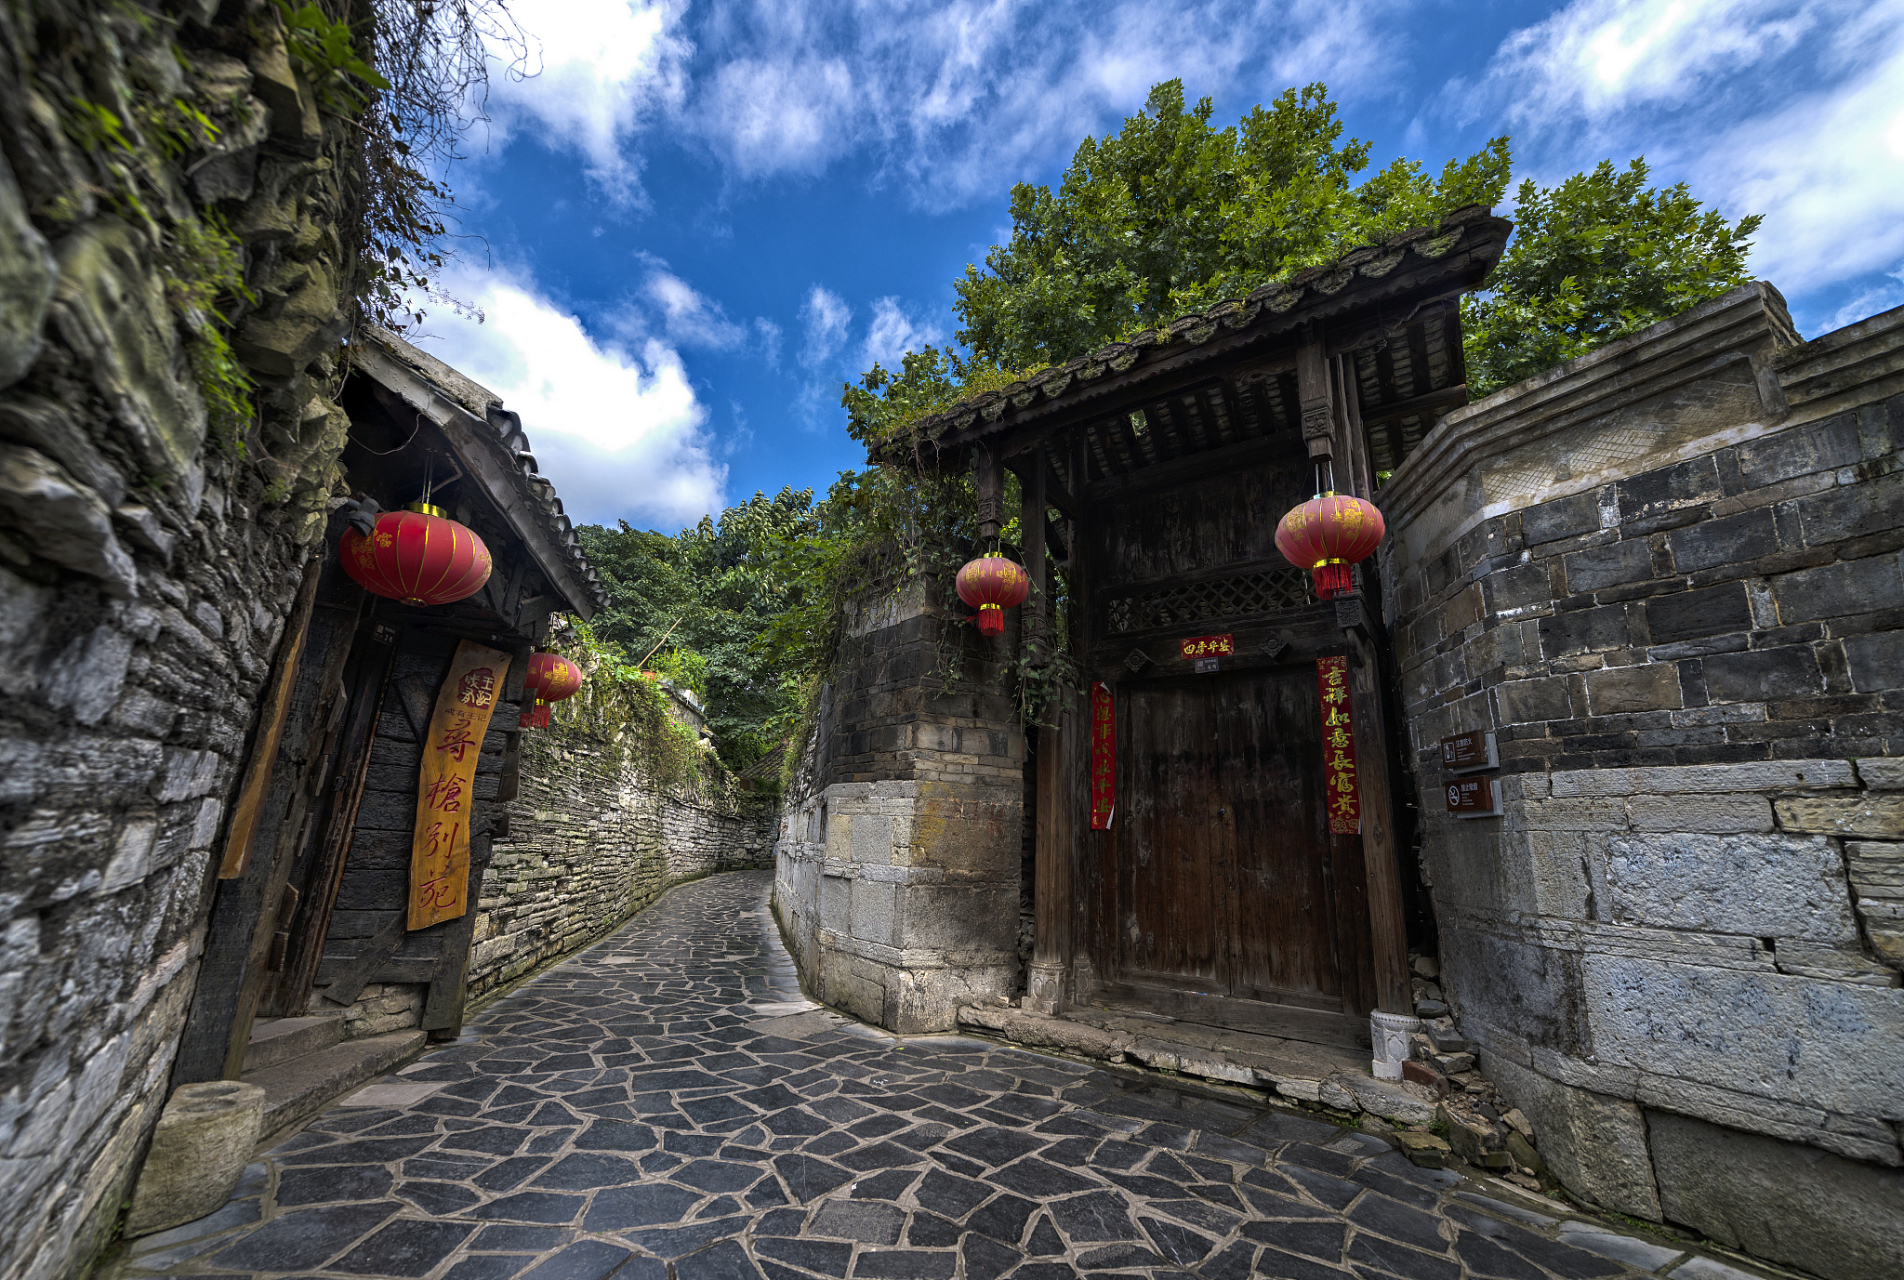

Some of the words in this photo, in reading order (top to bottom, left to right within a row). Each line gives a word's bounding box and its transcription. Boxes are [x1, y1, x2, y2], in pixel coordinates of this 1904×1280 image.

[1184, 639, 1230, 654] 四季平安
[1322, 666, 1358, 815] 吉祥如意長富貴
